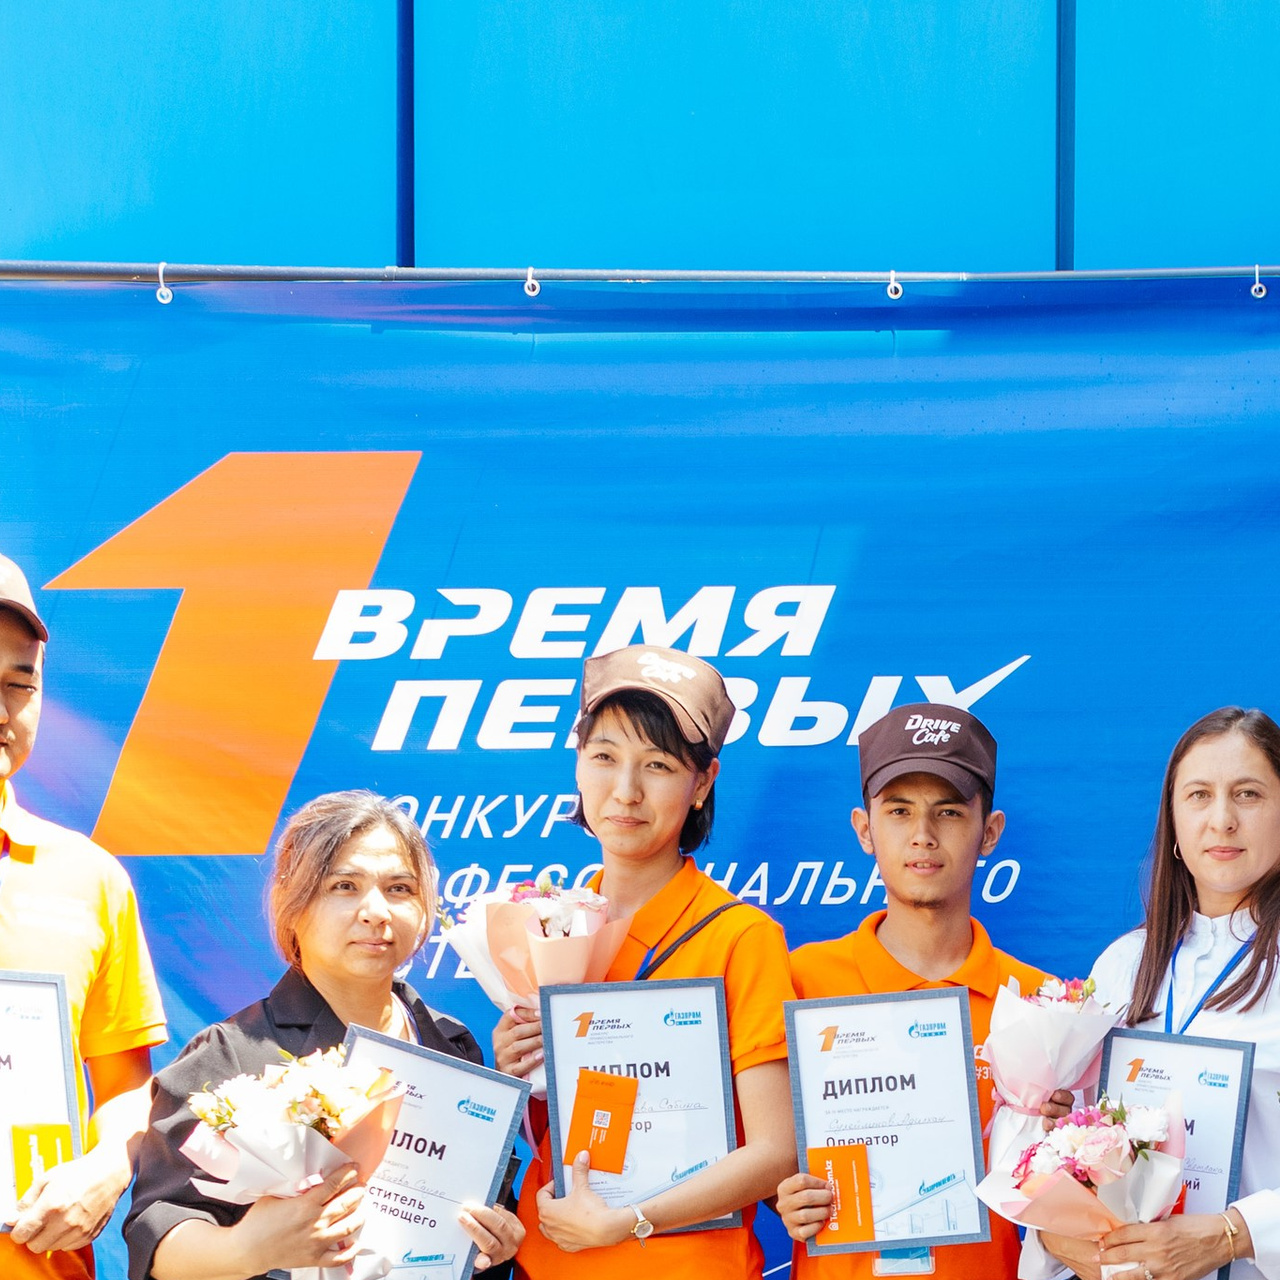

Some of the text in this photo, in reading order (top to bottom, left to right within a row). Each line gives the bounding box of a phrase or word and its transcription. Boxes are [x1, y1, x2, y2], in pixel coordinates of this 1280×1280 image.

[312, 584, 837, 660] ВРЕМЯ
[371, 654, 1032, 751] ПЕЫХ
[904, 714, 962, 734] DRIVE
[912, 728, 951, 746] Cafe
[383, 793, 601, 840] ОНКУР
[675, 1010, 701, 1019] ГАЗПРОМ
[919, 1021, 947, 1032] ГАЗПРОМ
[577, 1061, 671, 1081] ИПЛОМ
[822, 1073, 917, 1101] ДИПЛОМ
[390, 1129, 447, 1161] ЛОМ
[826, 1133, 899, 1148] Оператор
[368, 1185, 426, 1210] ститель
[372, 1201, 438, 1229] яющего
